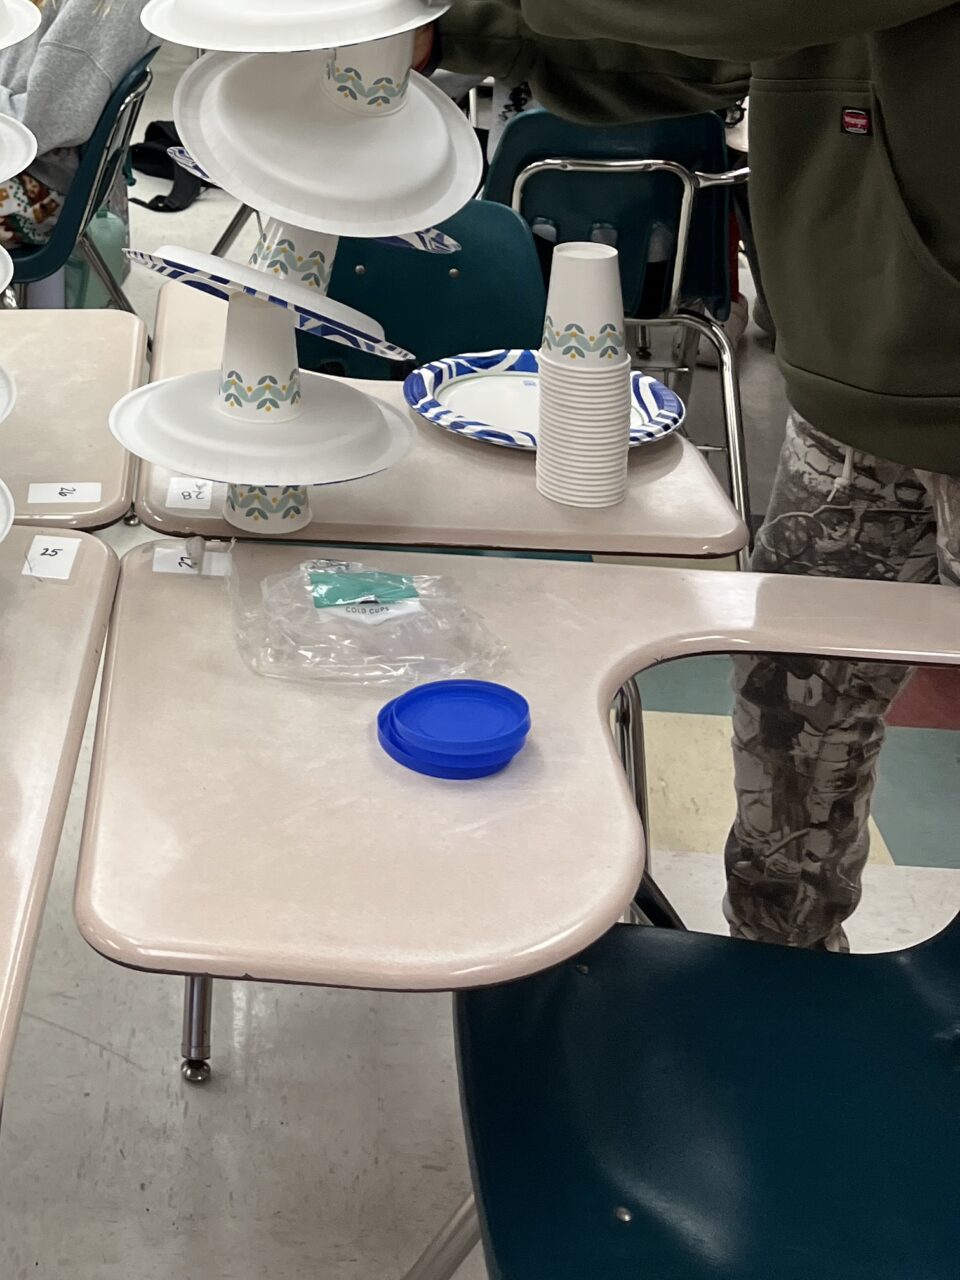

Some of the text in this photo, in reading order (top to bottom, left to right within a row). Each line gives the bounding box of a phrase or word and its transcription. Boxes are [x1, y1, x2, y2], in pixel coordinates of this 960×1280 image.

[40, 548, 63, 557] 25
[345, 606, 390, 615] COLD CUPS
